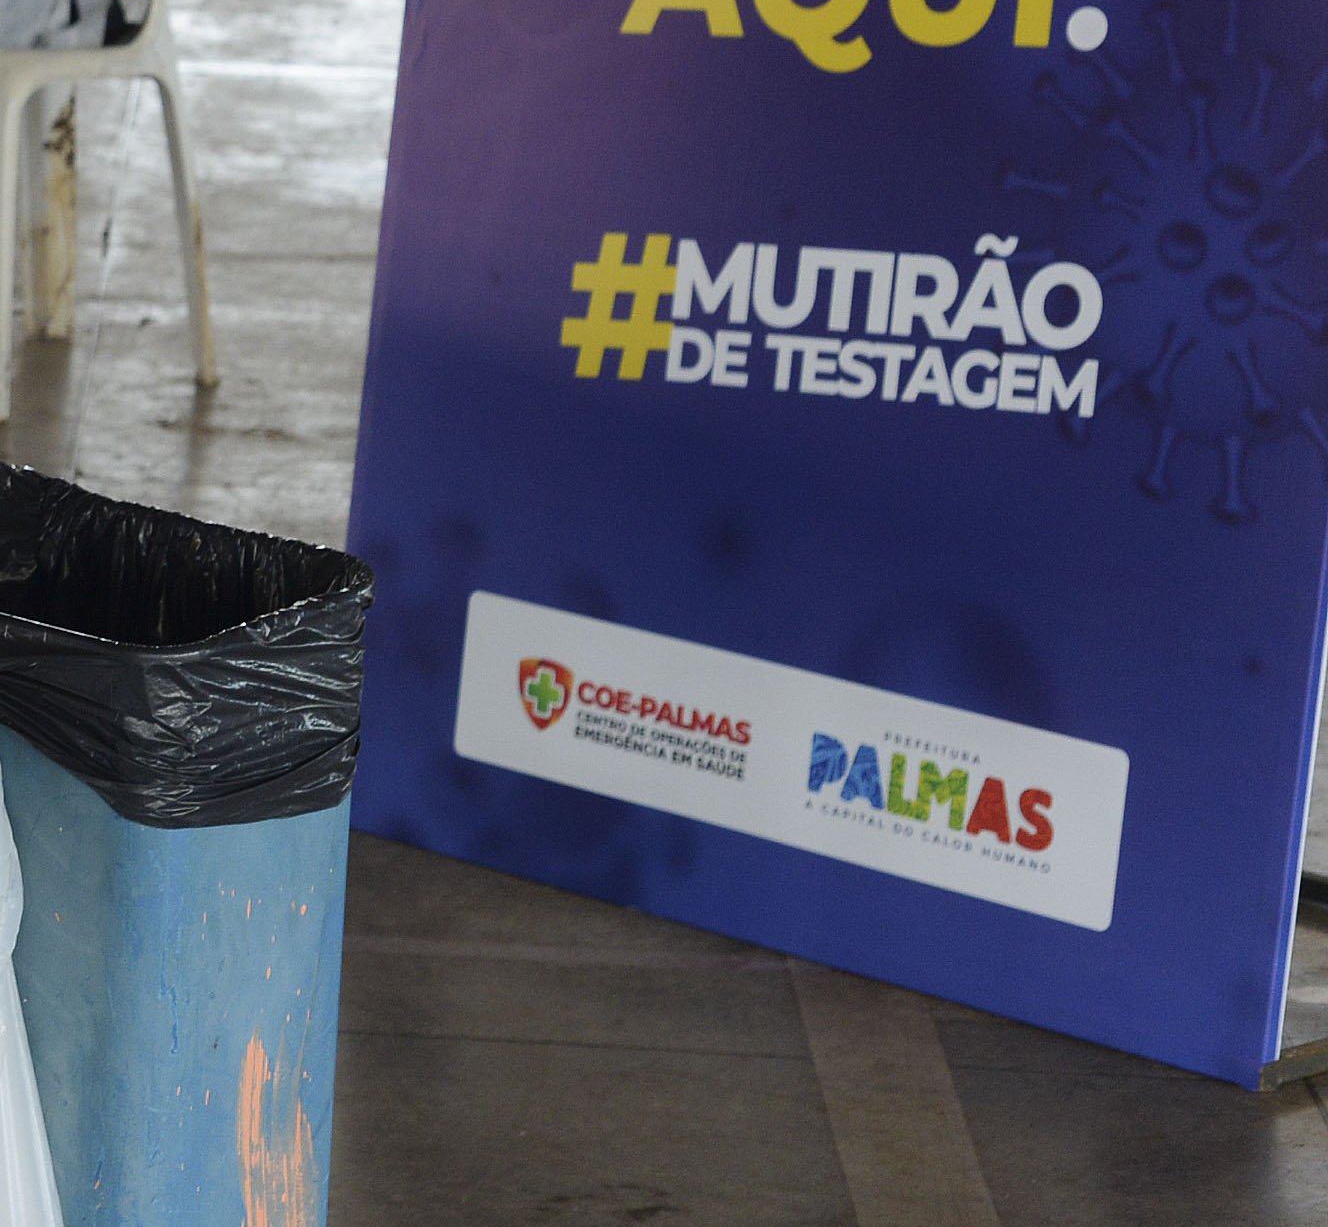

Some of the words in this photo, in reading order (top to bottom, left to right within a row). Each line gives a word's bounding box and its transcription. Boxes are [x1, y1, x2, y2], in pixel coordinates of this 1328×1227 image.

[560, 232, 1104, 381] #MUTIRÃO
[664, 325, 752, 389] DE
[764, 332, 1100, 419] TESTAGEM
[576, 710, 627, 734] CENTRO
[630, 723, 646, 737] DE
[650, 729, 727, 760] OPERAÇÕES
[730, 749, 746, 763] DE
[577, 681, 753, 745] COE-PALMAS
[883, 730, 982, 765] PREFEITURA
[575, 724, 668, 759] EMERGÊNCIA
[672, 749, 693, 766] EM
[697, 757, 745, 780] SAÚDE
[807, 731, 1055, 852] PALMAS
[804, 798, 814, 810] A
[821, 802, 885, 830] CAPITAL
[893, 822, 915, 838] DO
[922, 830, 974, 852] CALOR
[981, 847, 1052, 874] HUMANO
